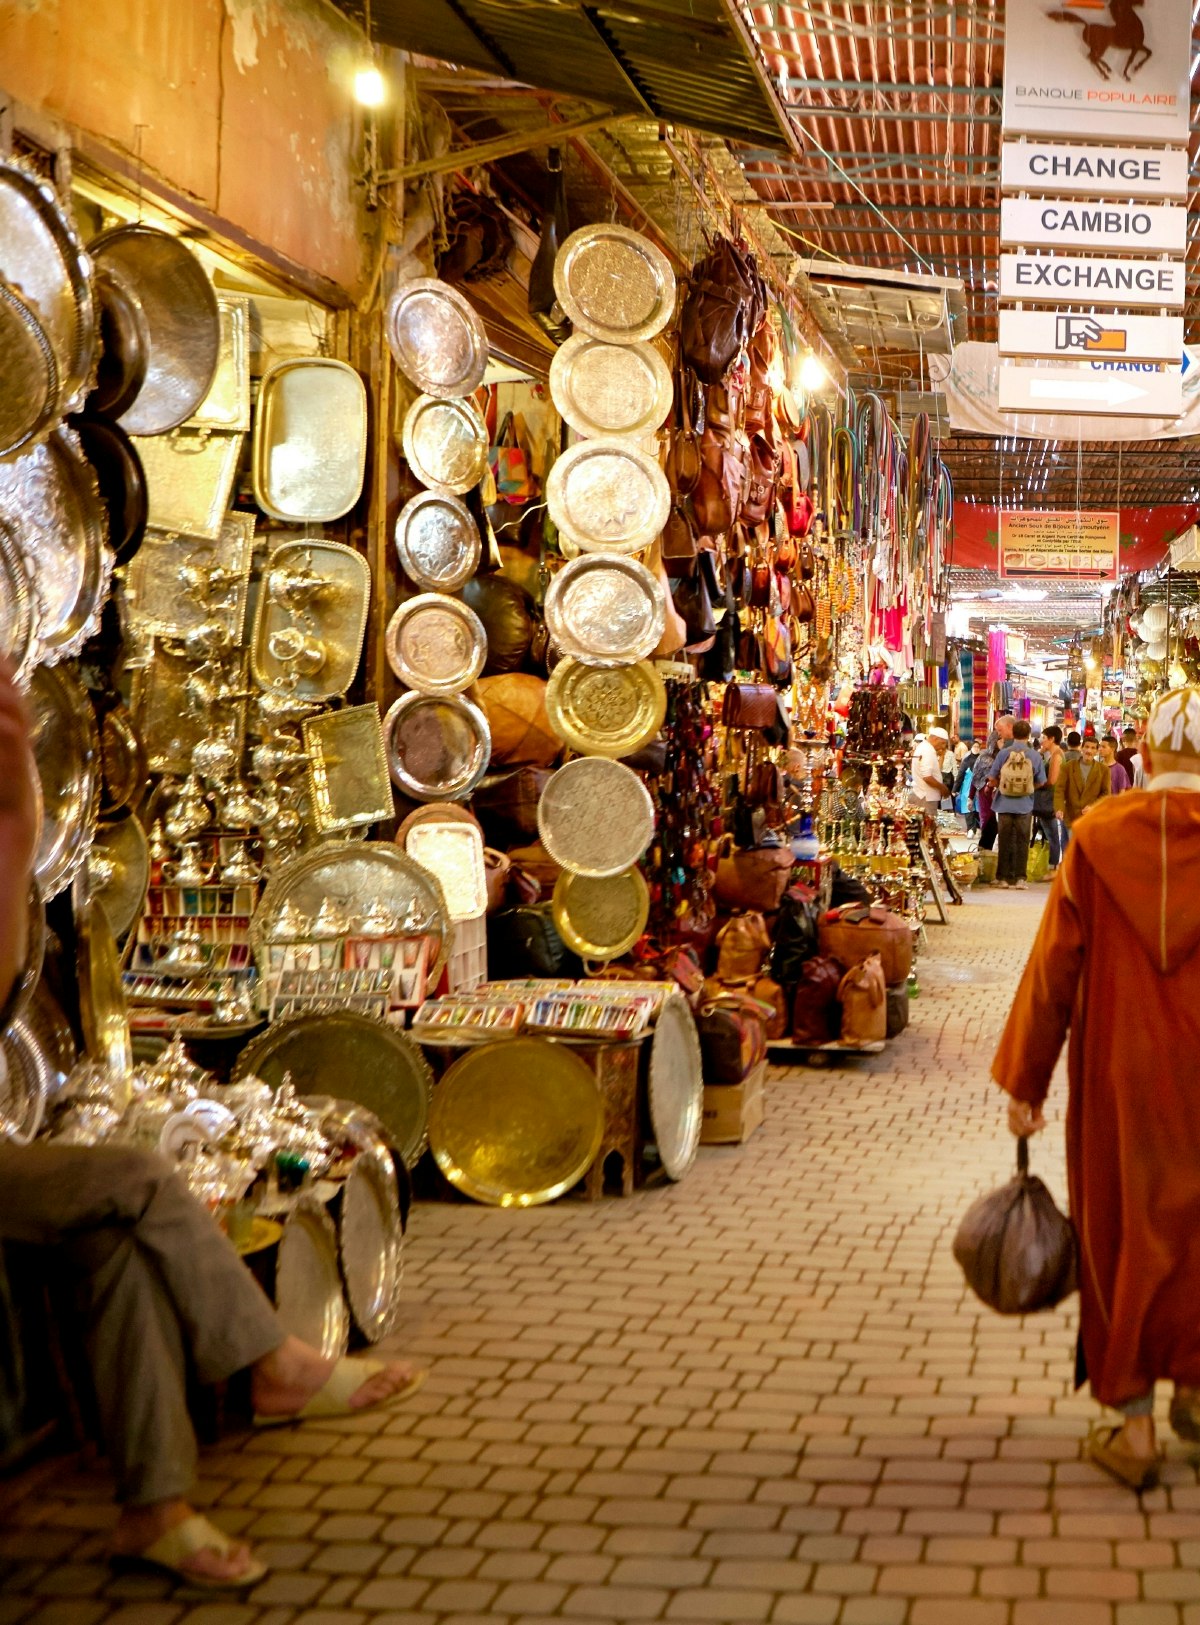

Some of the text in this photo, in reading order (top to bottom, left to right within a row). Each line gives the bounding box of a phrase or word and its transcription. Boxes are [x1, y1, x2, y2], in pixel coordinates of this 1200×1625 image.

[1015, 86, 1177, 106] BANQUE POPULAIRE
[1028, 154, 1161, 181] CHANGE
[1041, 208, 1152, 235] CAMBIO
[1016, 263, 1174, 292] EXCHANGE
